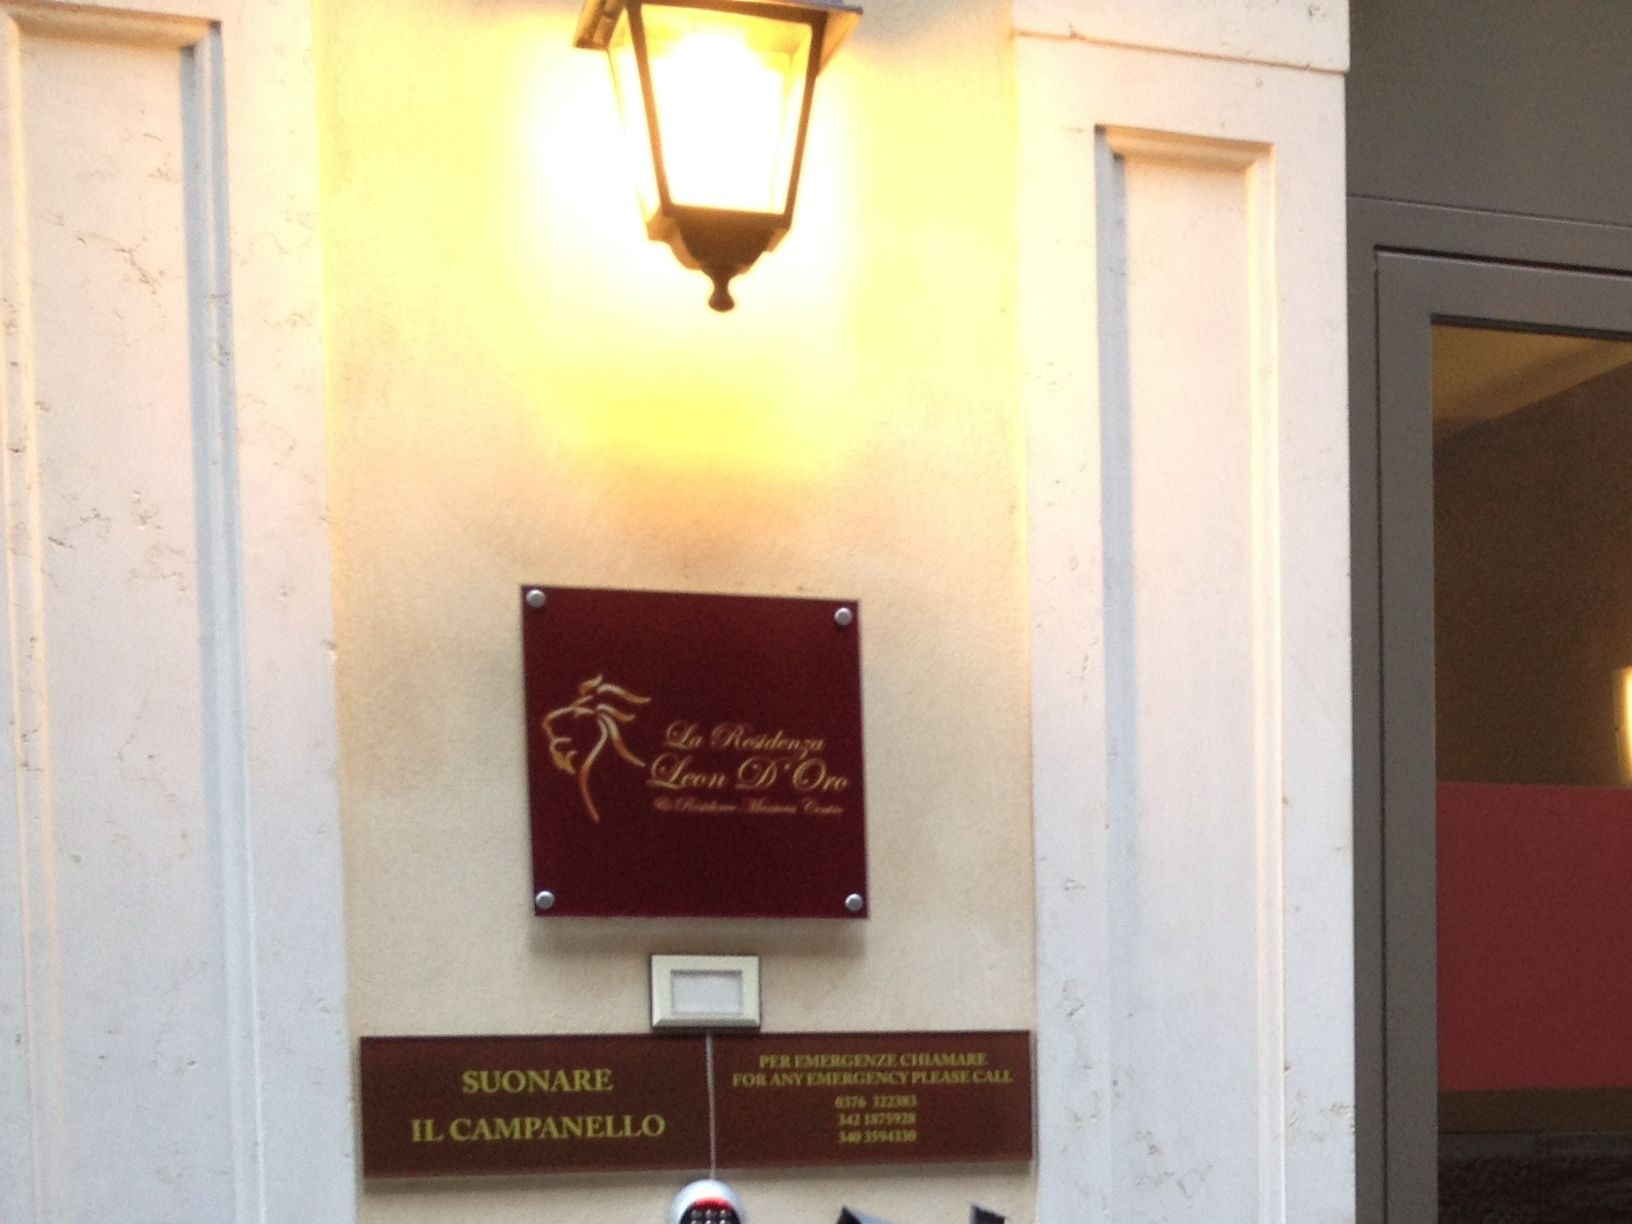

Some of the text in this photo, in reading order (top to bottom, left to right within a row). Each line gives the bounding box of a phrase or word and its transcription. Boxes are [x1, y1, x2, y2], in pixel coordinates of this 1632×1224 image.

[664, 720, 826, 758] La Residenza
[647, 752, 727, 791] Leon
[759, 1052, 987, 1068] PER EMERGENZE CHIAMARE
[462, 1068, 613, 1094] SUONARE
[732, 1069, 1013, 1087] FOR ANY EMERGENCY PLEASE CALL
[411, 1114, 666, 1142] IL CAMPANELLO
